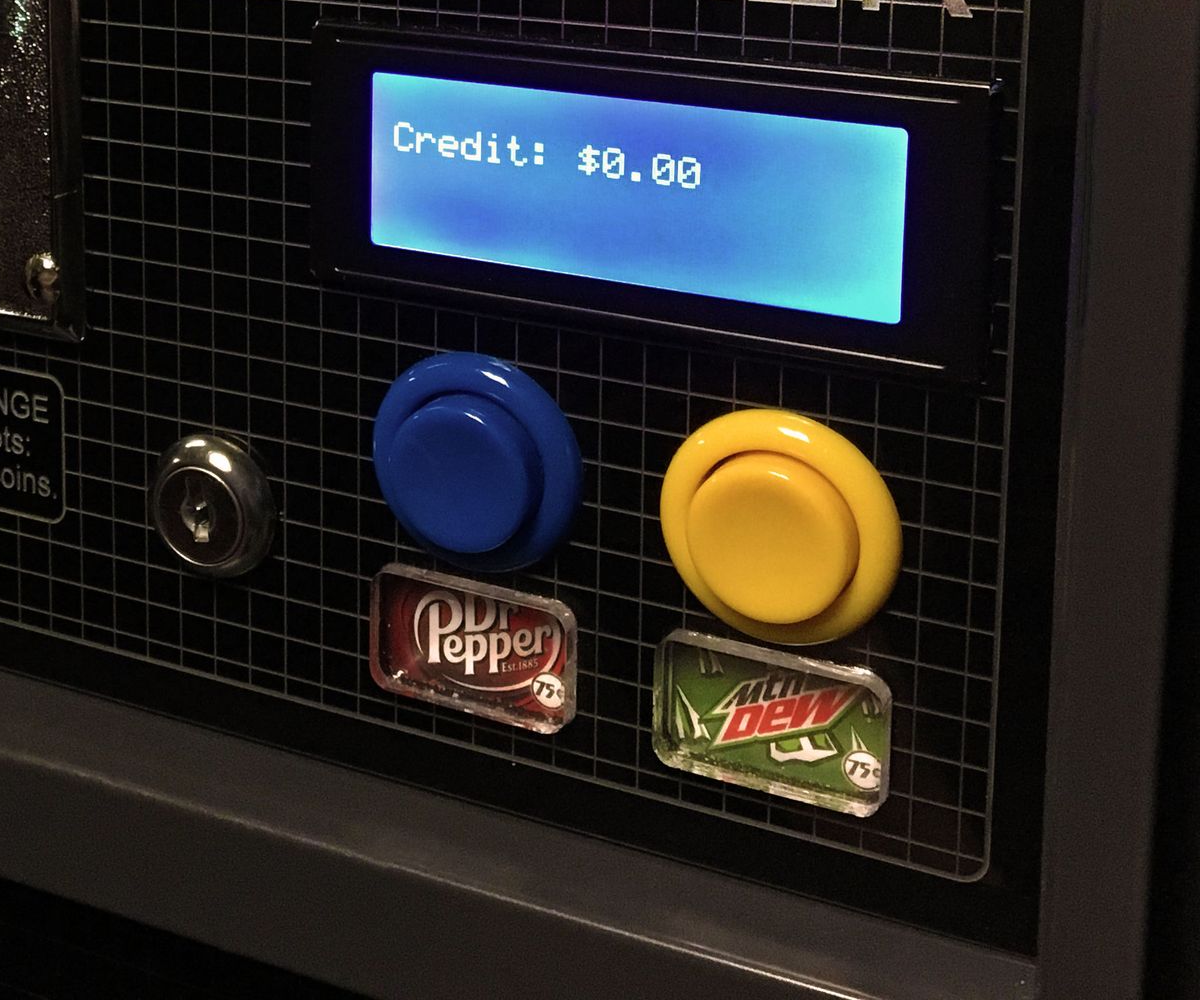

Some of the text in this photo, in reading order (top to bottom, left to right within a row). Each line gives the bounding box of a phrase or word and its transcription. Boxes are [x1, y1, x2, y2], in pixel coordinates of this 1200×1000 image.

[393, 121, 702, 190] Credit: $0.00
[426, 591, 552, 675] Pepper
[464, 592, 520, 632] Dr
